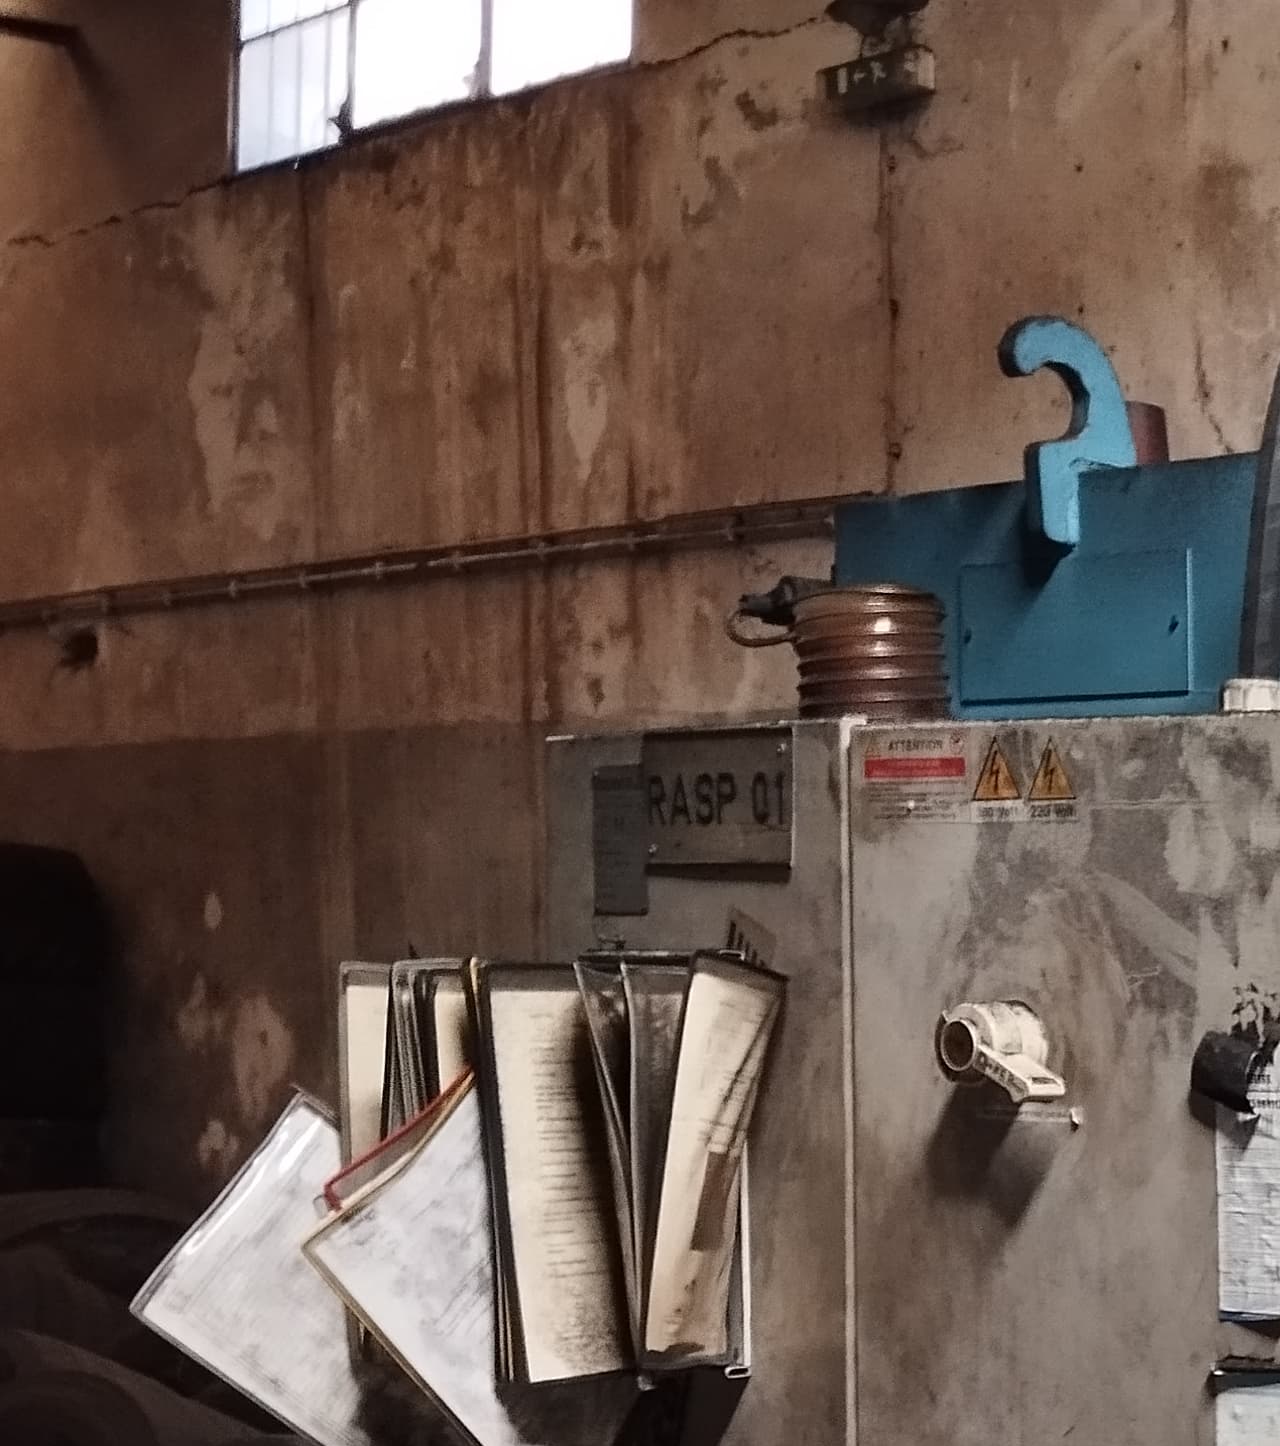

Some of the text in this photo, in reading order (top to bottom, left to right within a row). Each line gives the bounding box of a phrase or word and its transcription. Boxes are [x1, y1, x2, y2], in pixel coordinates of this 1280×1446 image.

[887, 737, 943, 752] ATTENTION
[647, 770, 786, 826] RASP 01
